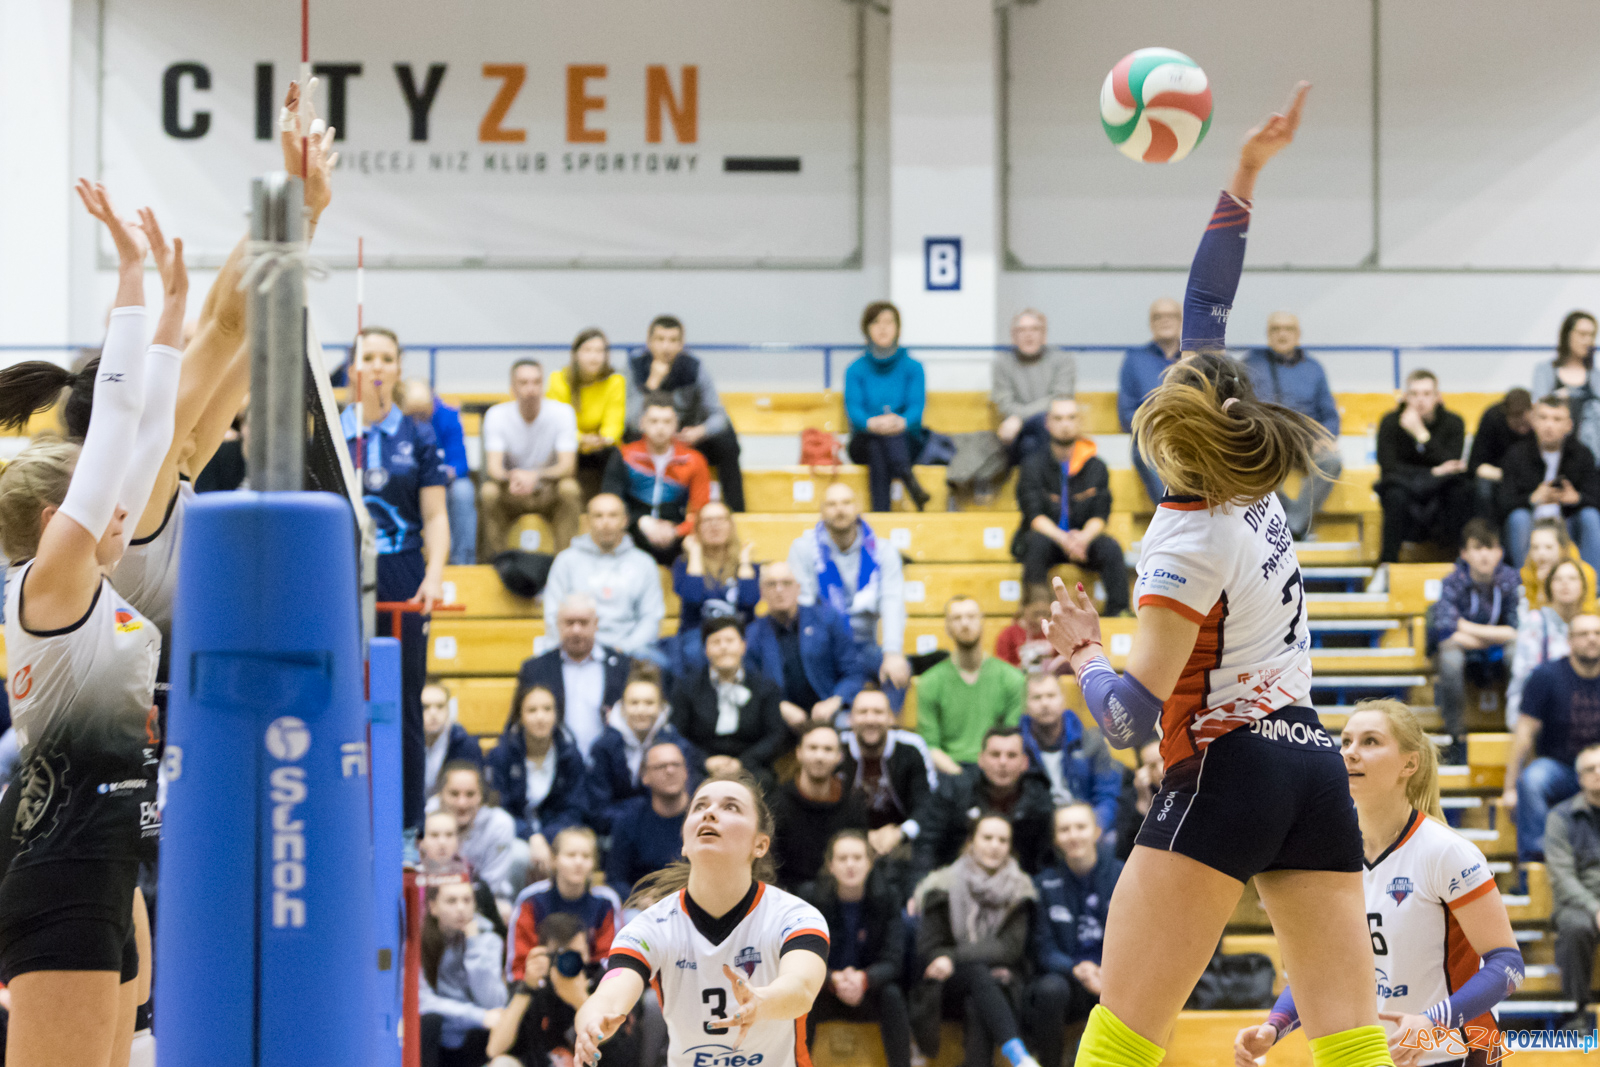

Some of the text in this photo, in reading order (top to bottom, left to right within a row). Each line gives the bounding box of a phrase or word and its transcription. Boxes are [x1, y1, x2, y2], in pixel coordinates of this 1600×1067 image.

[162, 61, 699, 143] CITYZEN
[484, 151, 547, 172] KLUB
[562, 151, 698, 172] SPORTOWY
[929, 243, 958, 285] B
[1153, 568, 1187, 585] Enea
[1281, 566, 1305, 645] 7
[1461, 862, 1481, 879] Enea
[1367, 912, 1389, 956] 6
[1375, 983, 1408, 999] nea
[702, 987, 729, 1035] 3
[692, 1052, 764, 1067] Enea
